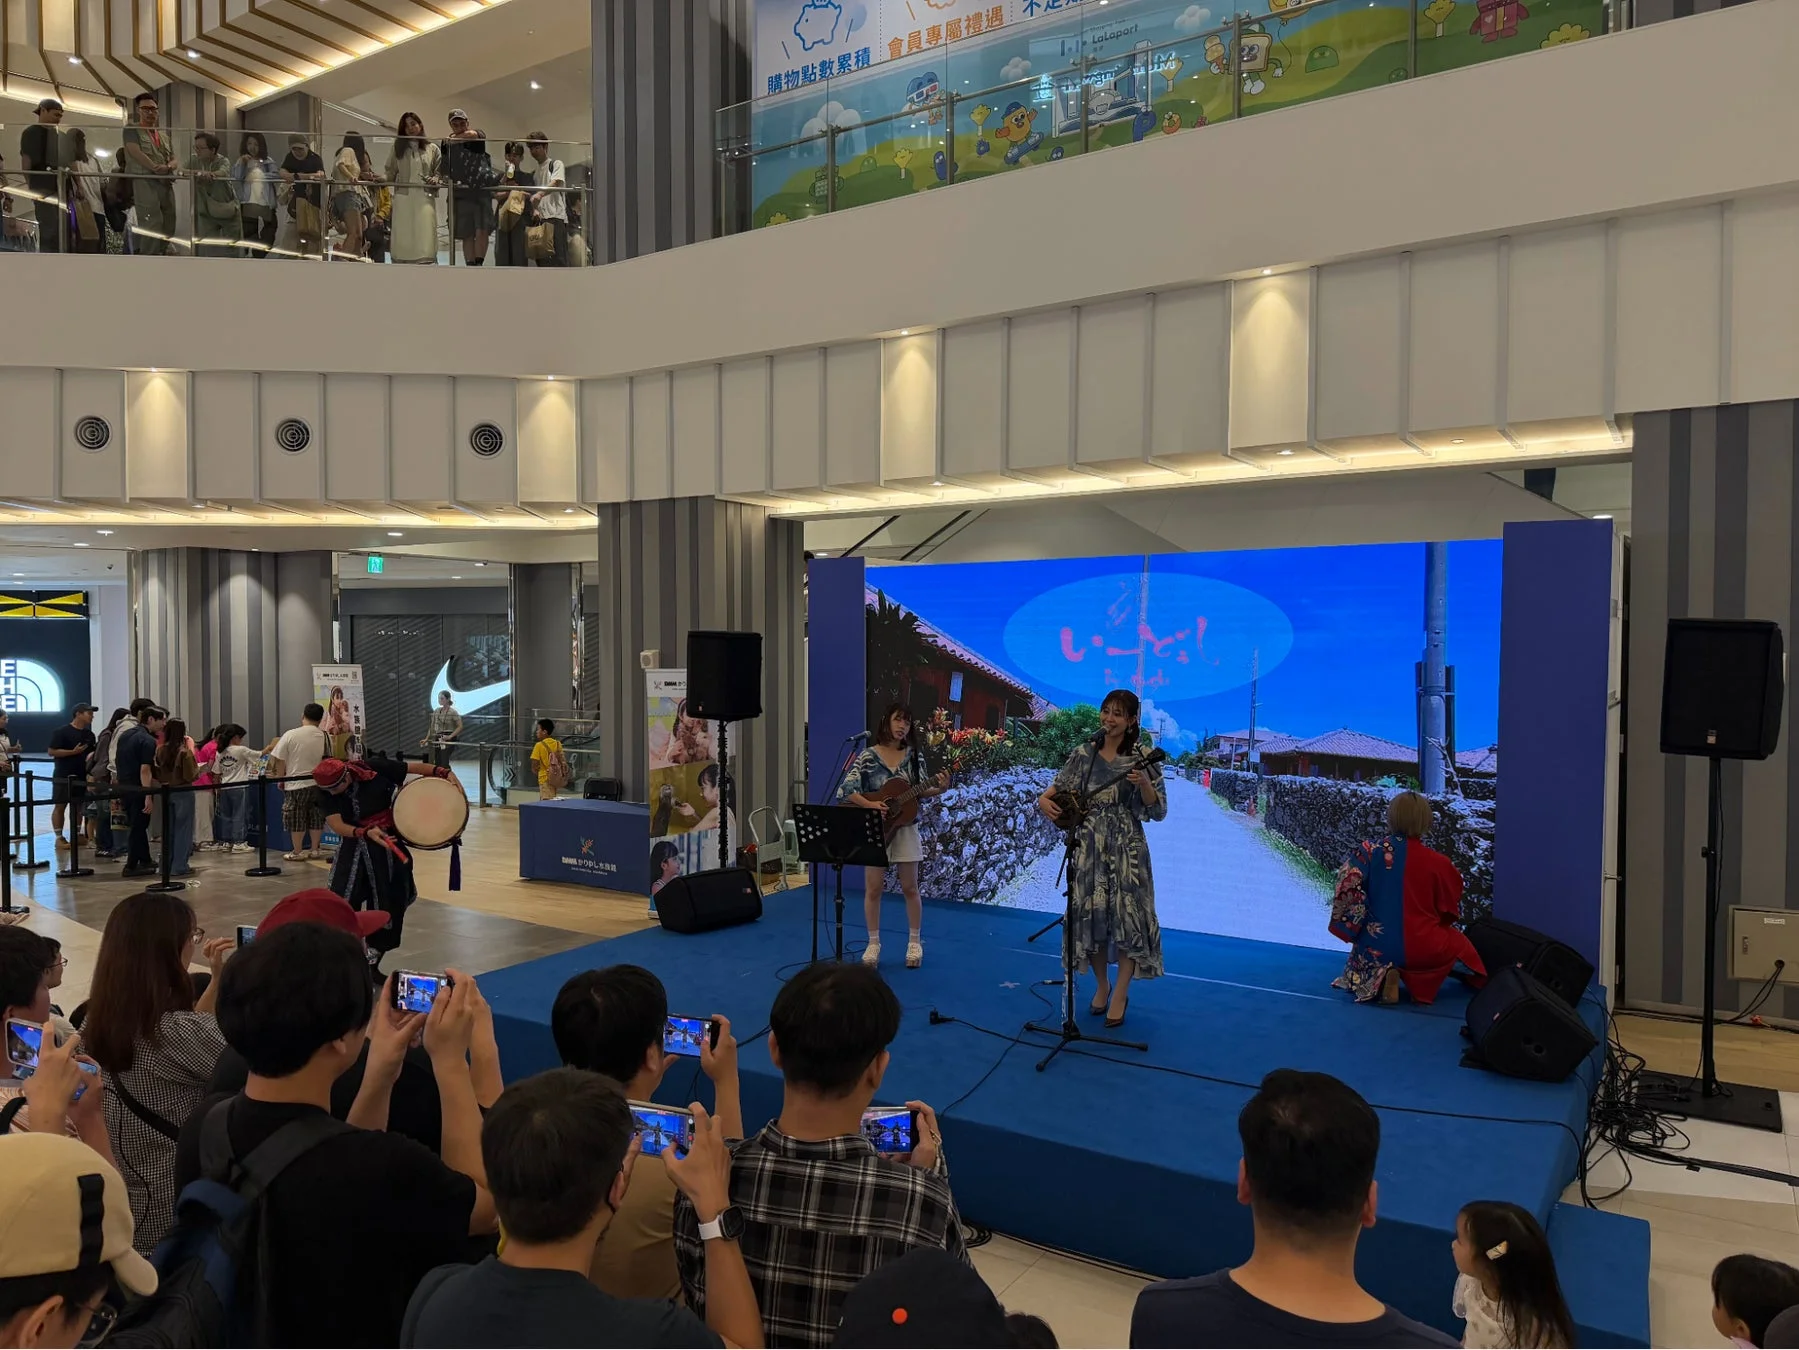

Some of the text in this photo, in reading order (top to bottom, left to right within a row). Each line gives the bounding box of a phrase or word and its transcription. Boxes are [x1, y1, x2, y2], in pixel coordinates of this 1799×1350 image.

[887, 6, 1004, 60] 會員專屬禮遇
[1092, 24, 1138, 44] LaLaport
[767, 47, 871, 95] 購物點數累積
